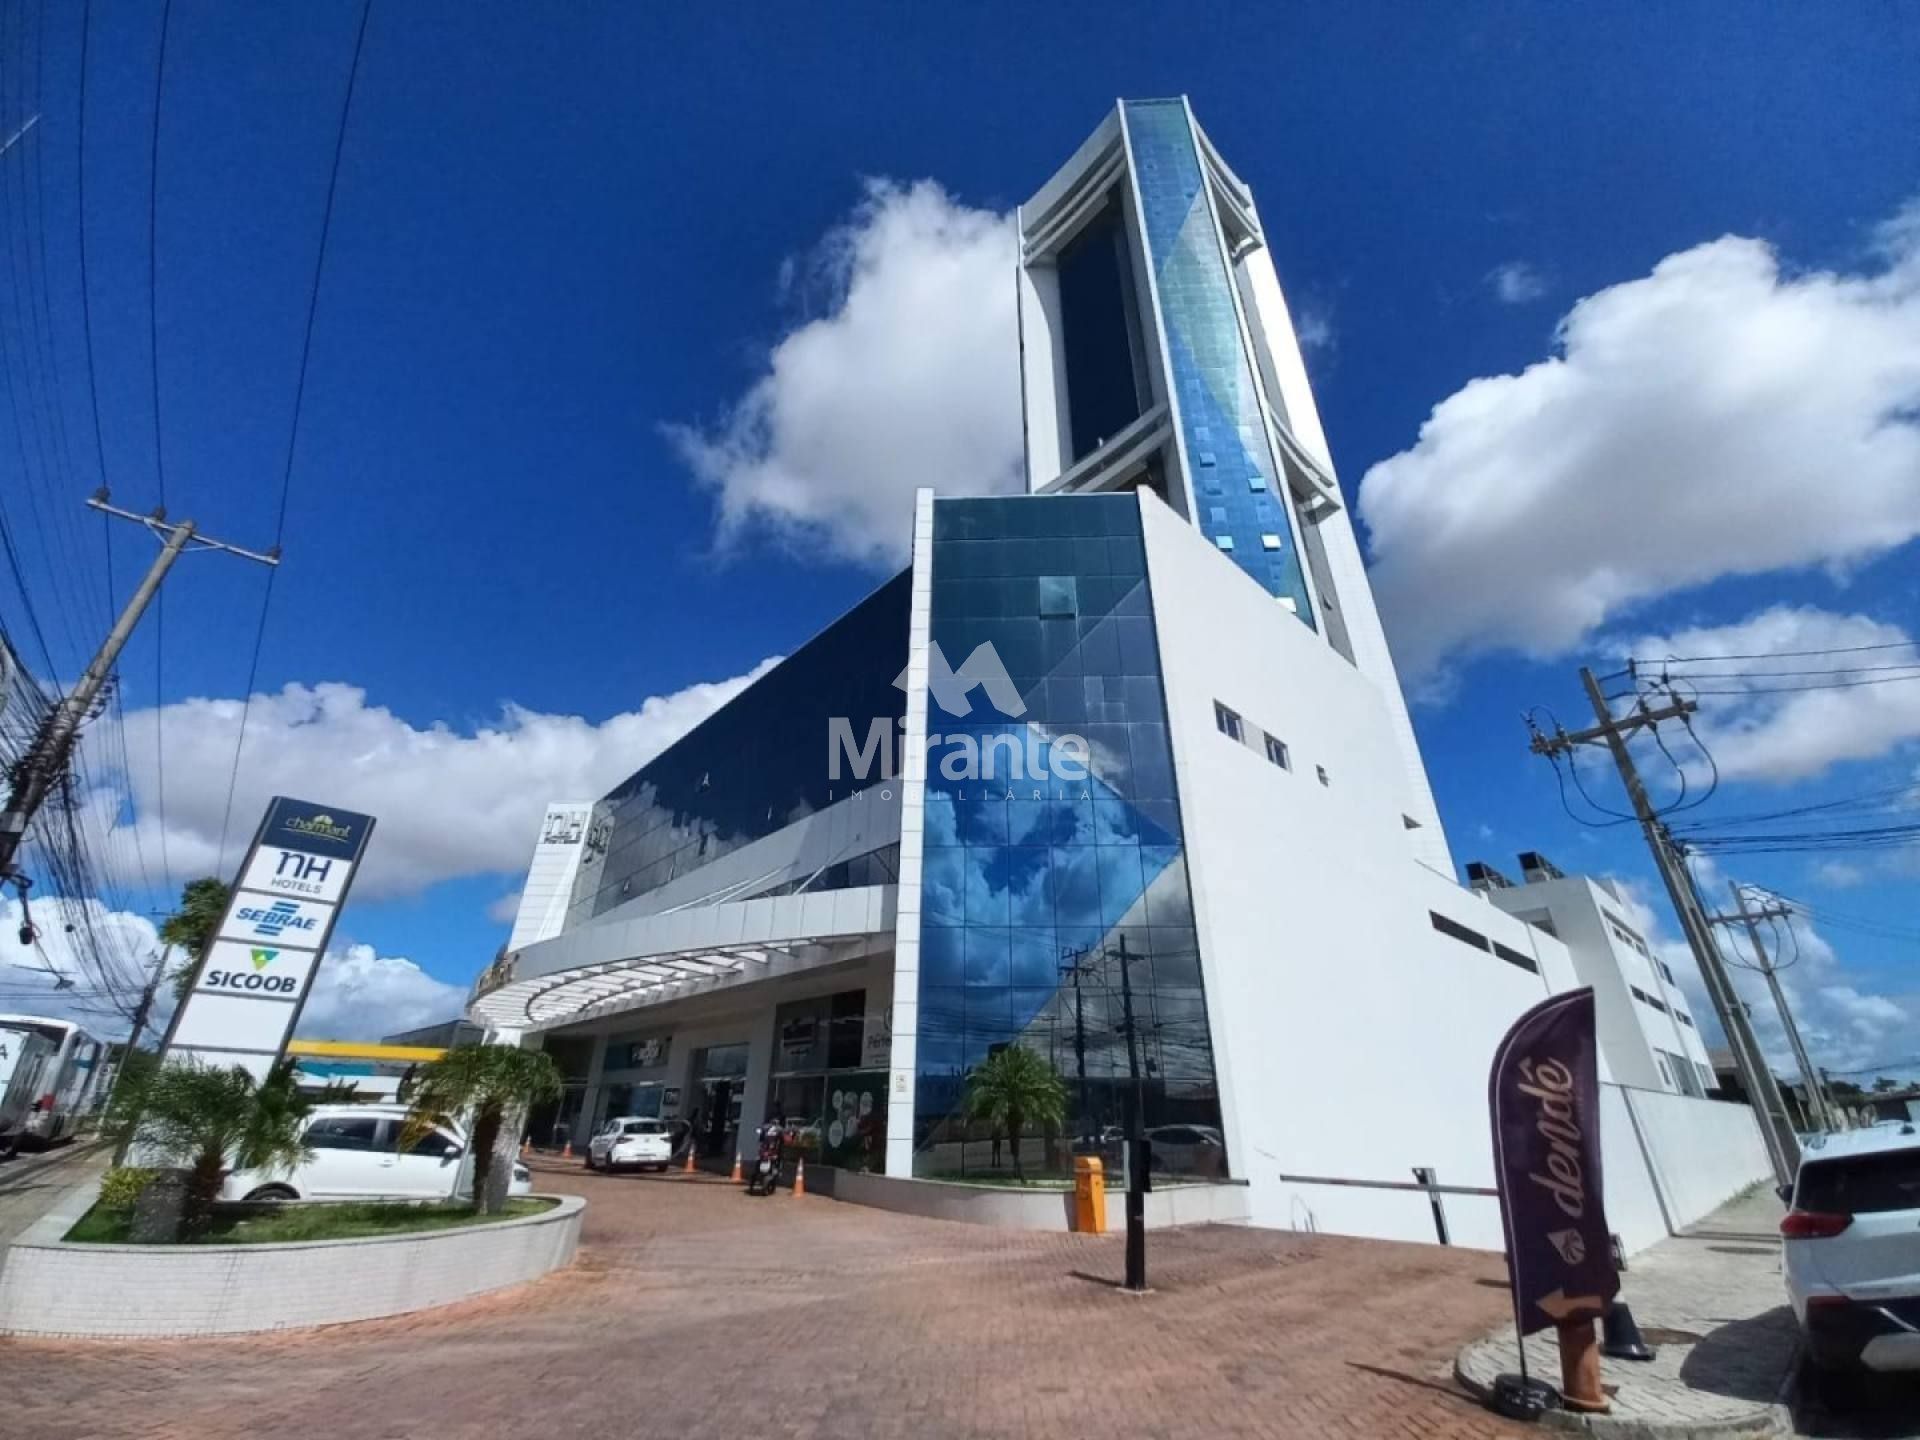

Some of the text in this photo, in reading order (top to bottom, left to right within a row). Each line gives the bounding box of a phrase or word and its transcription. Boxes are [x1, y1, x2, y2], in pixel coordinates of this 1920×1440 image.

[271, 879, 322, 895] HOTELS
[236, 908, 318, 930] SEBRAE
[206, 970, 297, 993] SICOOB
[1517, 1057, 1583, 1218] dendê
